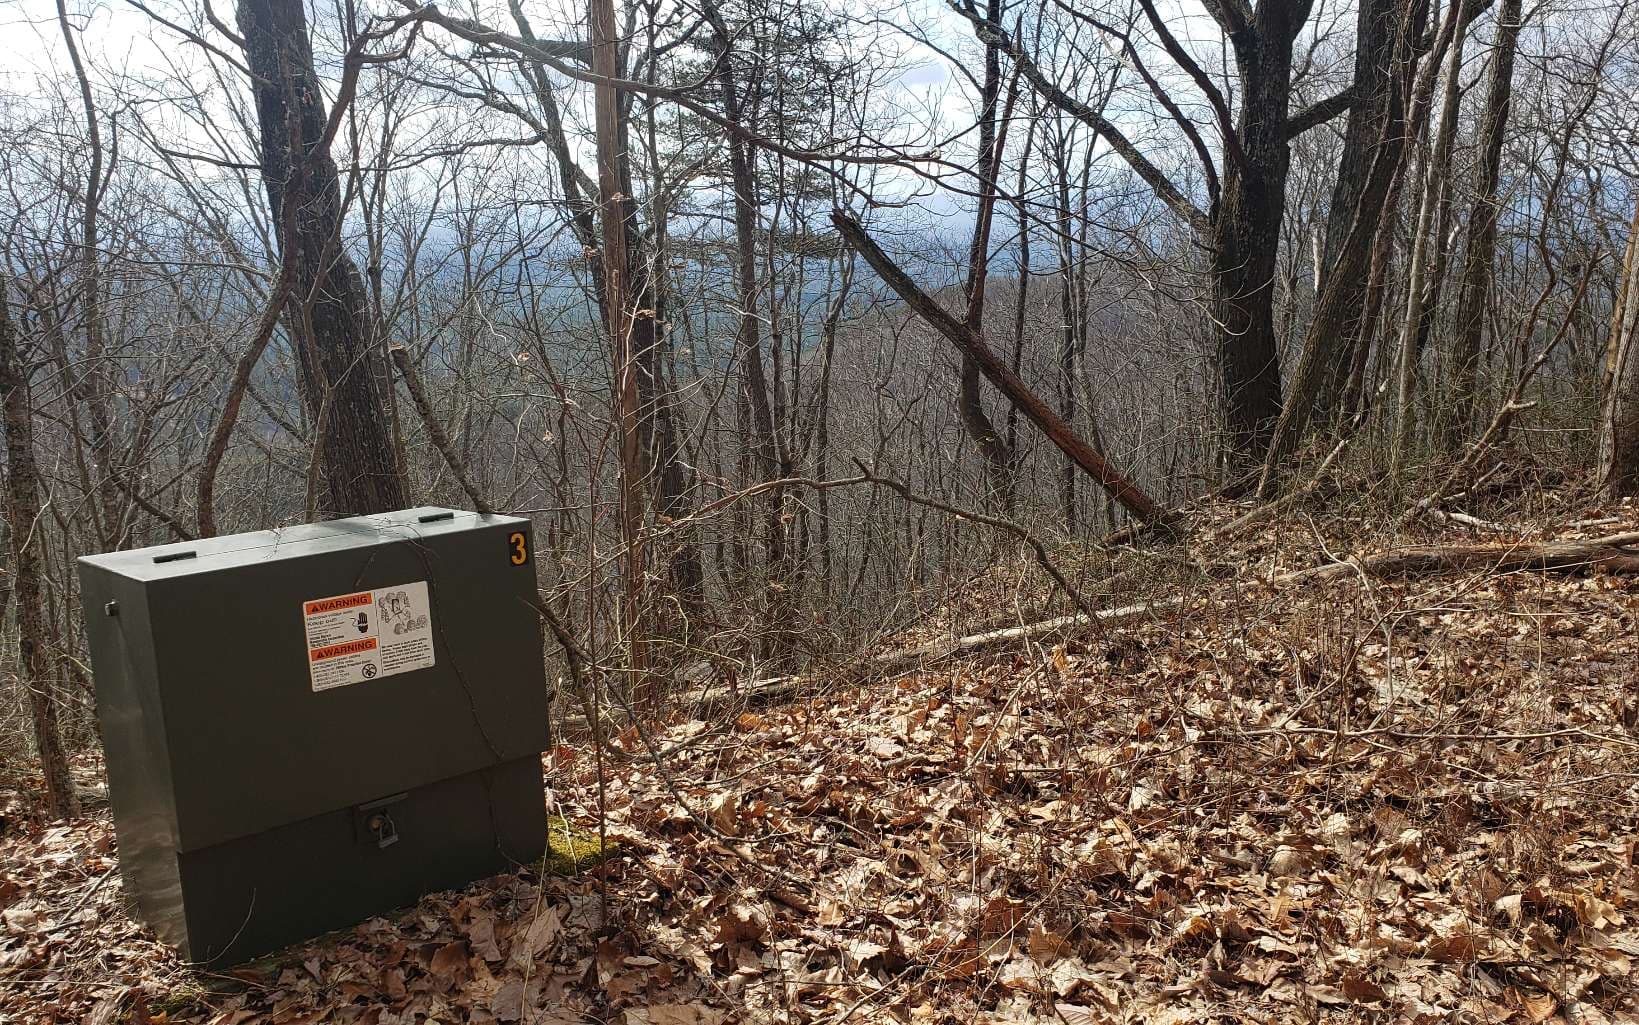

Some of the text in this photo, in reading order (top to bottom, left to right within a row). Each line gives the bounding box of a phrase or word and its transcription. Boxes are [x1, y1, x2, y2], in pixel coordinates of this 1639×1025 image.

[511, 533, 526, 565] 3
[320, 596, 368, 610] WARNING
[323, 641, 373, 657] WARNING
